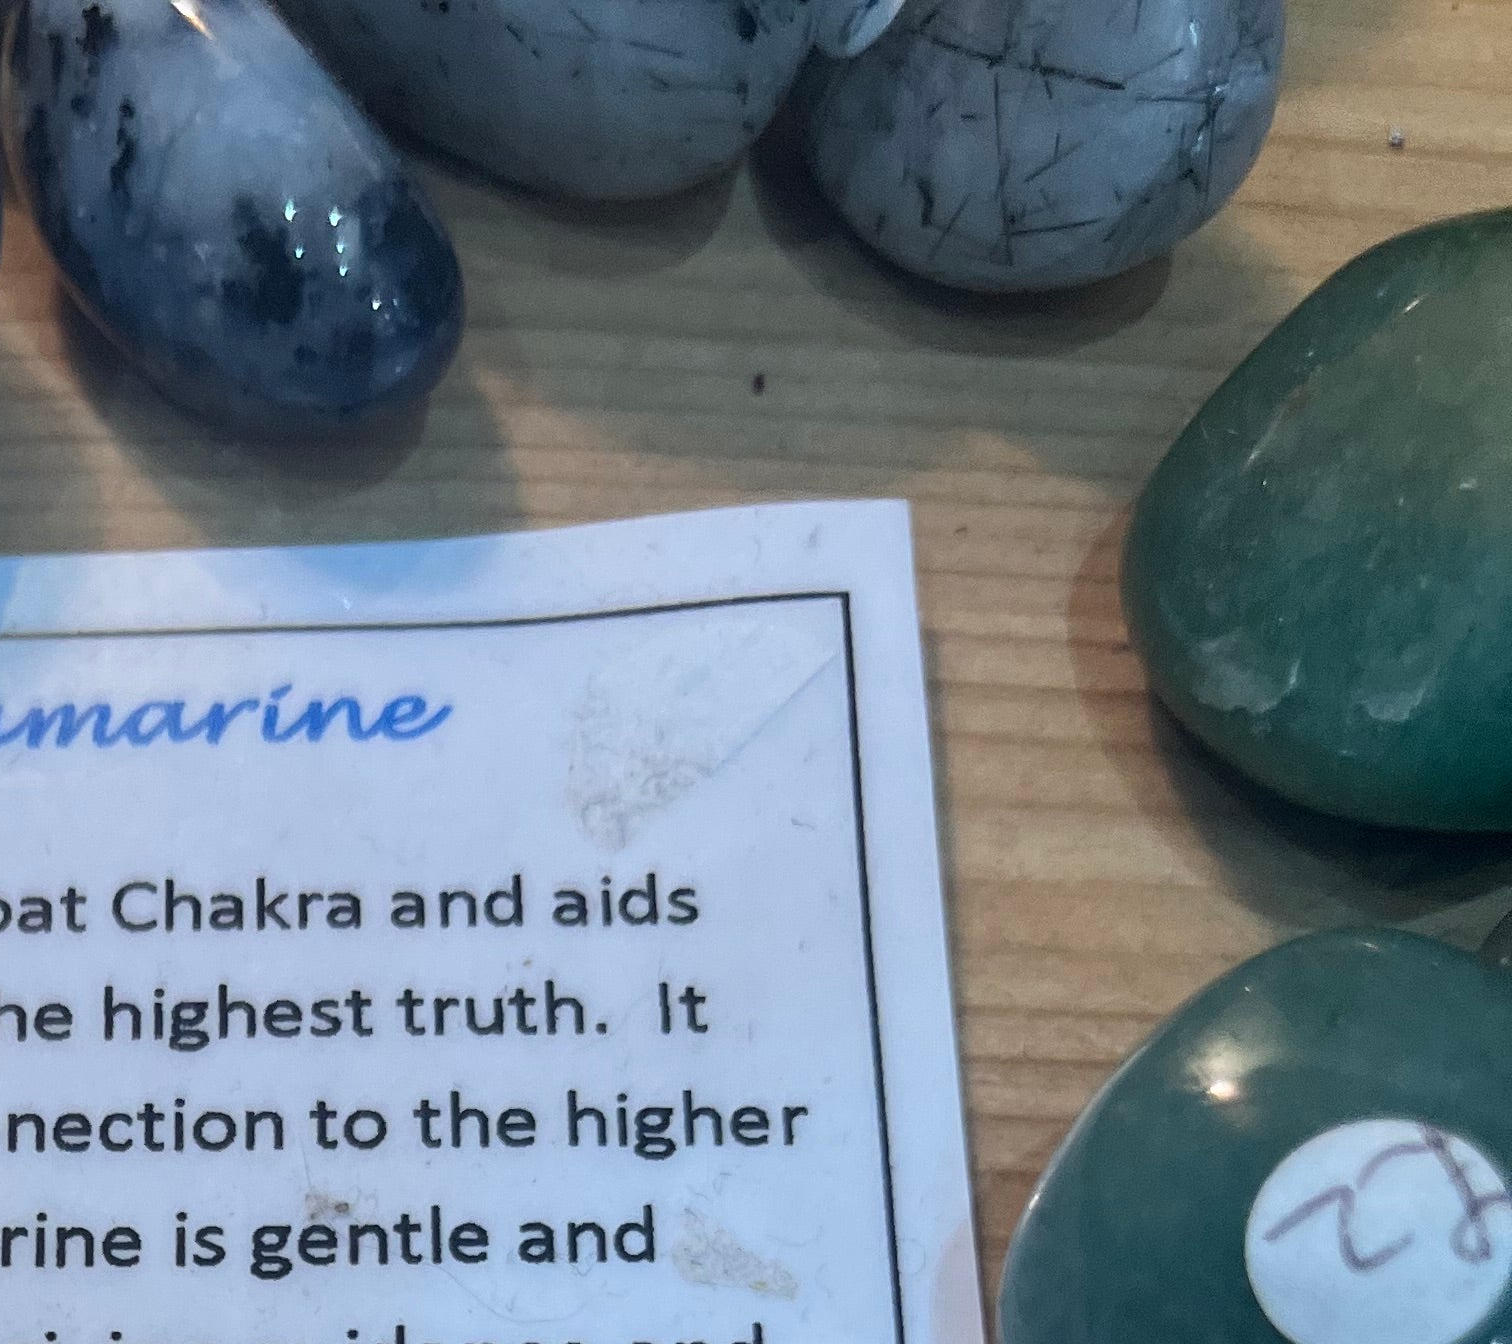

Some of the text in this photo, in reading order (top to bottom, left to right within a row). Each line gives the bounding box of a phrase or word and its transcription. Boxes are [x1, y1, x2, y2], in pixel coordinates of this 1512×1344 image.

[110, 875, 363, 935] Chakra
[389, 872, 525, 931] and
[550, 871, 701, 929] aids
[101, 983, 375, 1054] highest
[393, 978, 609, 1039] truth.
[656, 980, 709, 1037] It
[307, 1098, 389, 1152] to
[411, 1089, 538, 1151] the
[565, 1088, 809, 1163] higher
[173, 1210, 227, 1270] is
[248, 1201, 490, 1283] gentle
[516, 1203, 657, 1266] and
